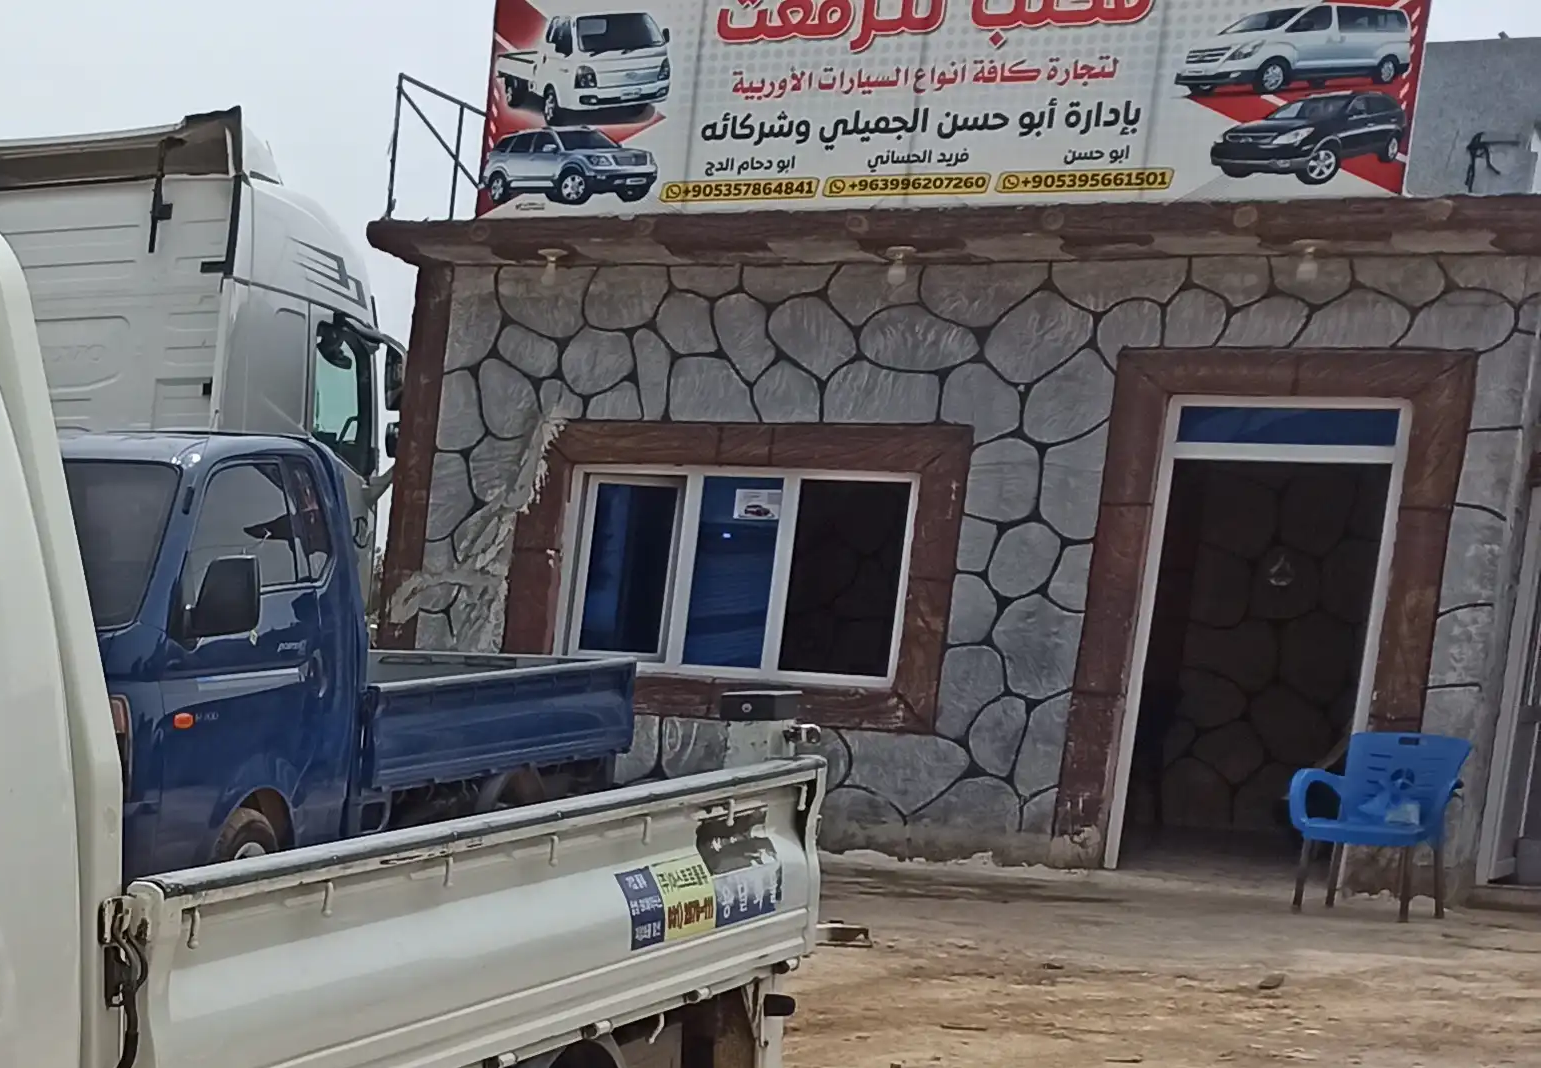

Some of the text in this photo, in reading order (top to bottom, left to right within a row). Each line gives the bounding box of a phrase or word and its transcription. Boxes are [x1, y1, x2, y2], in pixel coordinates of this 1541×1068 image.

[817, 65, 910, 95] السيارات
[972, 59, 1042, 84] كافة
[1046, 55, 1119, 86] لتجارة
[700, 98, 1141, 151] بإدارة أبو حسن الجميلي وشركائه
[937, 148, 969, 167] فريد
[1063, 148, 1106, 166] حسن
[682, 179, 814, 199] +905357864841
[848, 175, 987, 193] +963996207260
[1021, 171, 1167, 190] +905395661501
